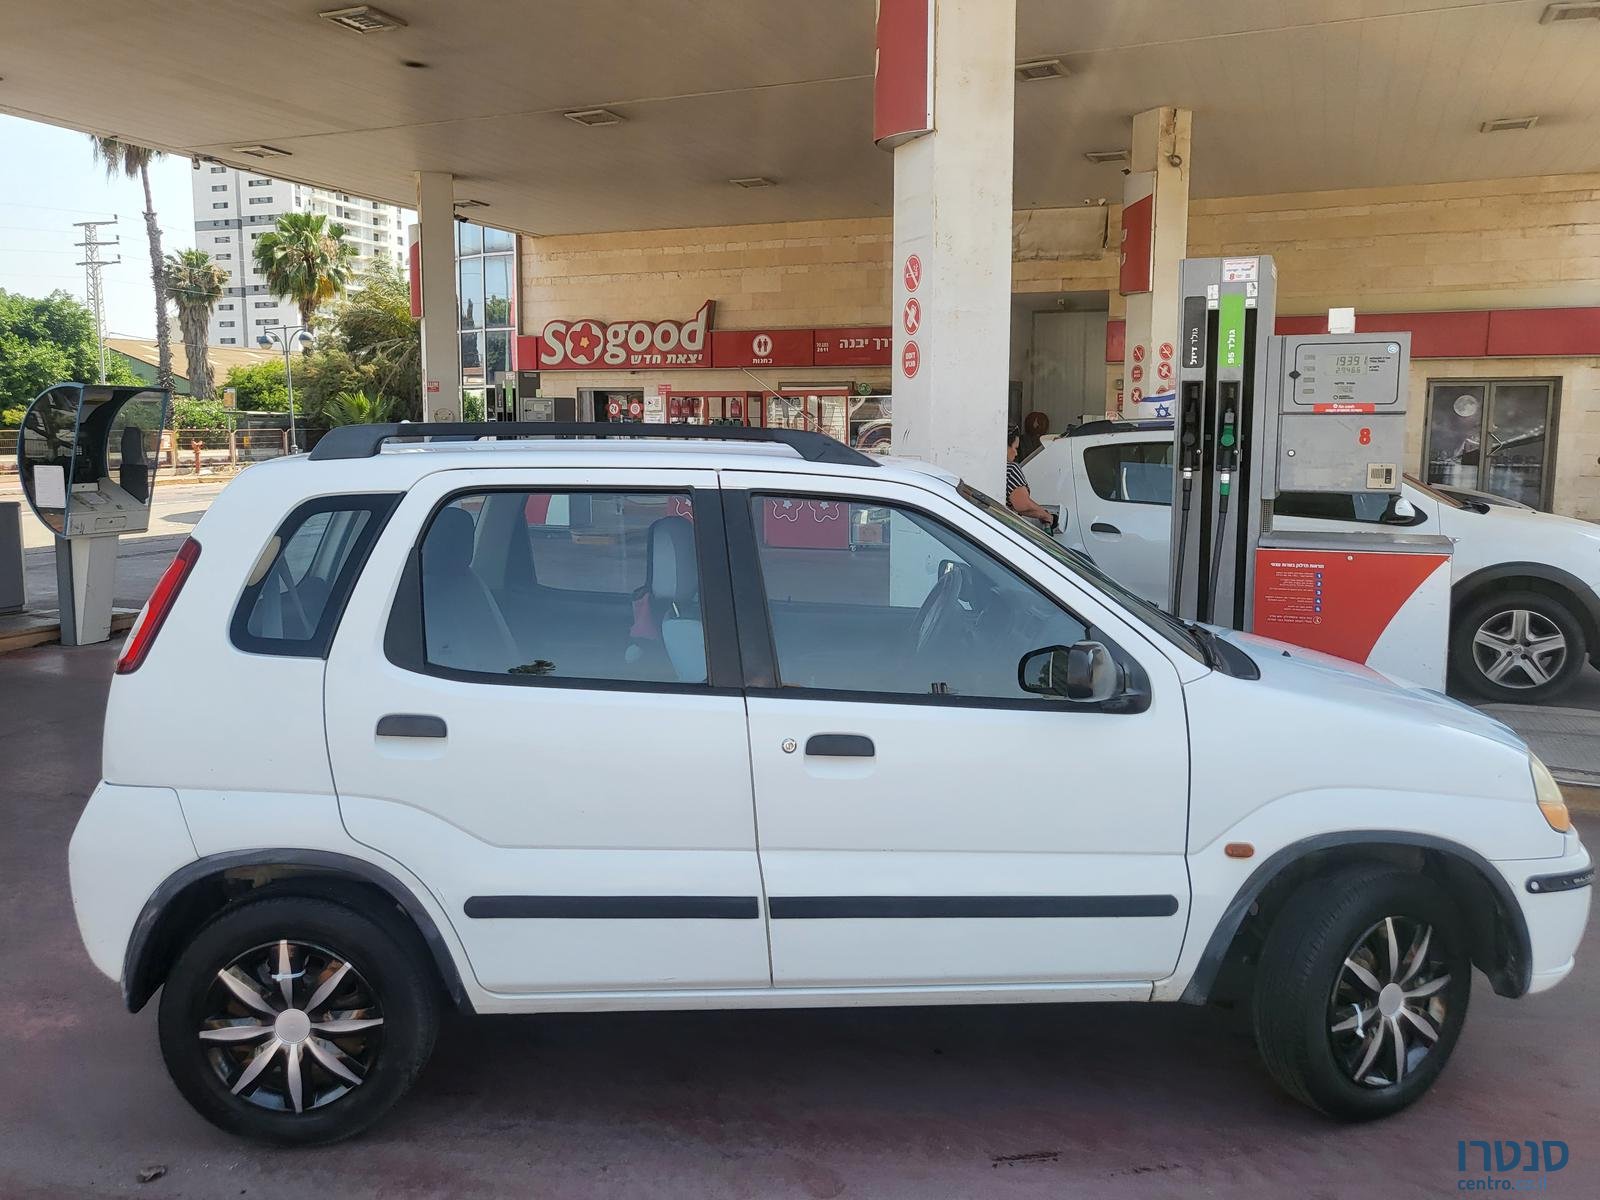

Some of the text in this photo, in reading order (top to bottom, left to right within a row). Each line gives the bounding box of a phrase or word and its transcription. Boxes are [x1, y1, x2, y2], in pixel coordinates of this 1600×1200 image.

[839, 337, 869, 349] יבנה
[630, 353, 703, 365] יצאת חדש
[1227, 351, 1235, 364] 95
[1359, 427, 1371, 445] 8
